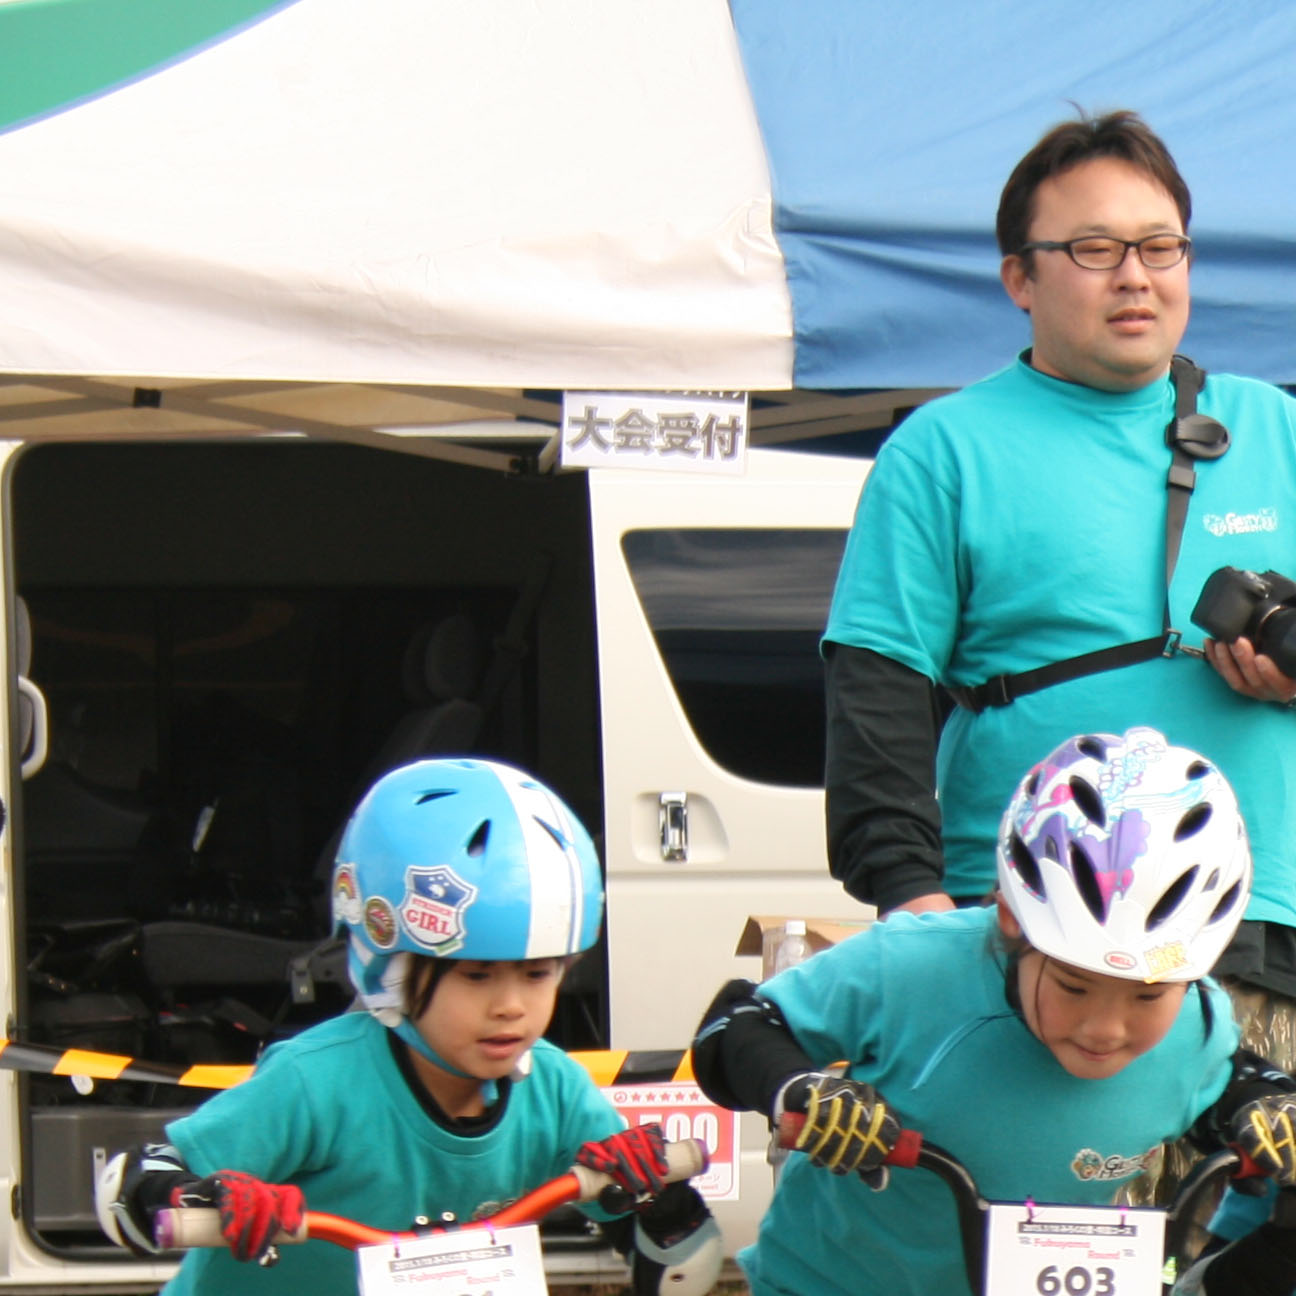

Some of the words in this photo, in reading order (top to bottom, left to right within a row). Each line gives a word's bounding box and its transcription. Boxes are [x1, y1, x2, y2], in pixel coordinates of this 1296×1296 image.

[566, 405, 744, 461] 大会受付
[405, 908, 450, 936] GIRL
